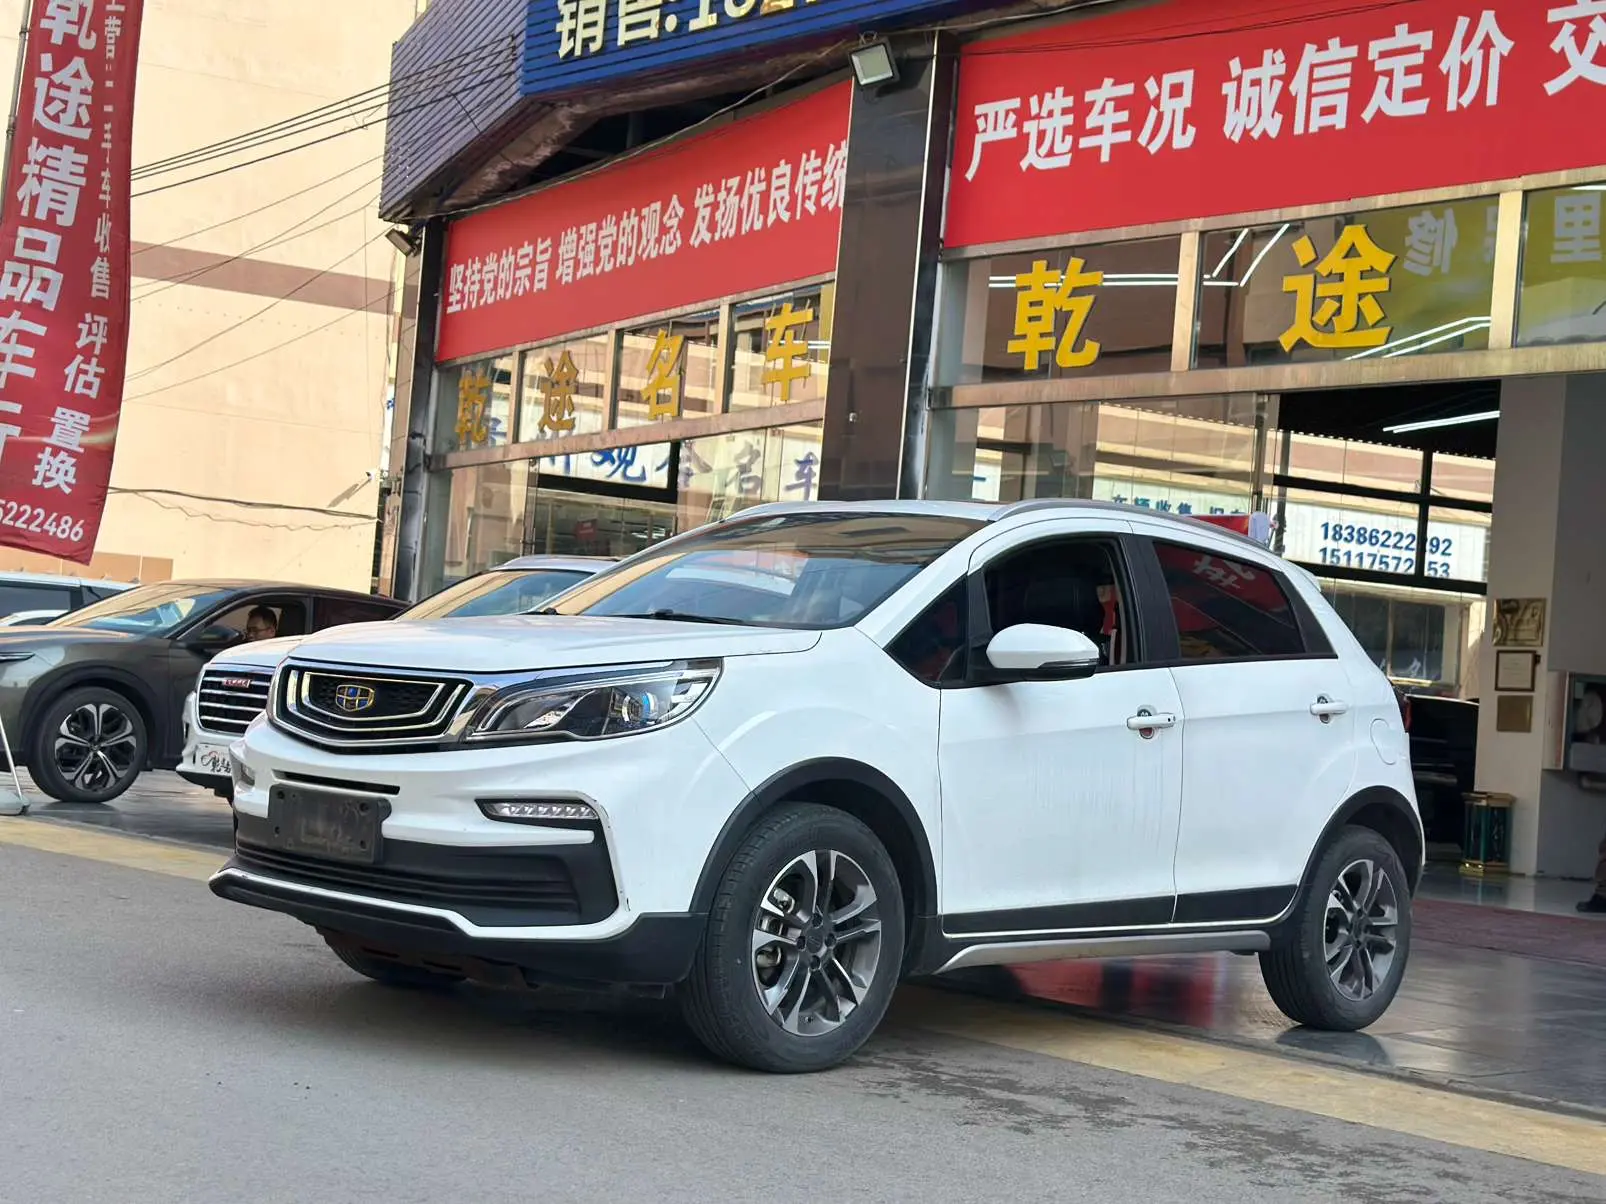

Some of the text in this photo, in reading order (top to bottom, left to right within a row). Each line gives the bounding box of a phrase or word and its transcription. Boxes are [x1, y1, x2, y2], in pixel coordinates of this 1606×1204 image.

[965, 69, 1197, 182] 严选车况
[1221, 10, 1515, 143] 诚信定价
[446, 237, 552, 314] 坚持党的宗旨
[555, 194, 685, 285] 增强党的观念
[1007, 224, 1397, 371] 乾途
[64, 312, 108, 399] 评估
[455, 302, 814, 446] 乾途名车
[32, 406, 91, 495] 置换
[1318, 546, 1451, 579] 1511757253
[1320, 521, 1453, 557] 1838622292
